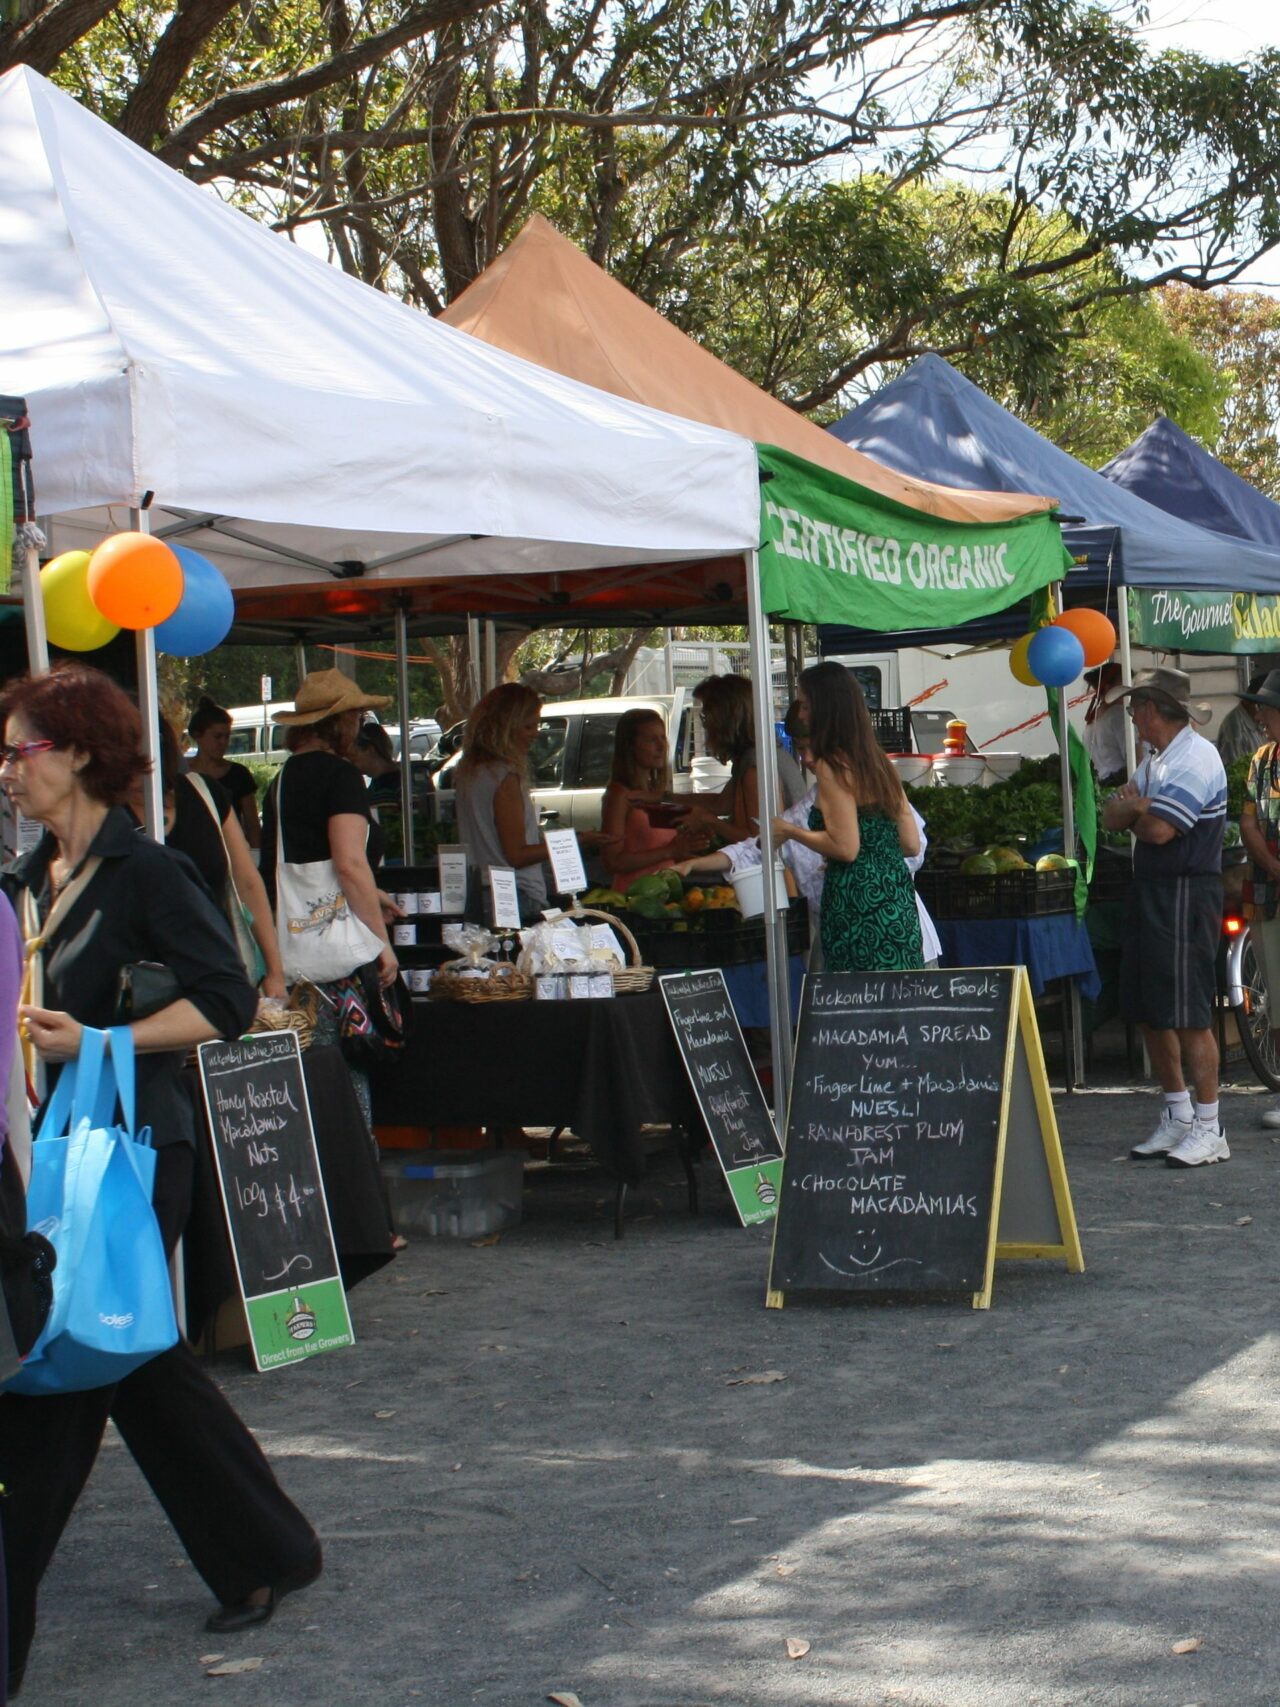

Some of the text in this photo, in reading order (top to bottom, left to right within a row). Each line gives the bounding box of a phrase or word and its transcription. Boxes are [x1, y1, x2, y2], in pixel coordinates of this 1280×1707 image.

[766, 501, 1015, 590] CERTIFIED ORGANIC
[1151, 590, 1182, 625] The
[811, 976, 1000, 1006] Tuckombil Native Foods
[919, 1024, 992, 1043] SPREAD
[860, 1074, 896, 1094] Lime
[901, 1079, 913, 1092] +
[216, 1081, 298, 1121] Honey Roasted
[851, 1100, 920, 1118] MUESLI
[916, 1119, 965, 1146] PLUM
[248, 1141, 279, 1167] Nuts
[847, 1146, 894, 1167] JAM
[801, 1174, 907, 1193] CHOCOLATE
[851, 1191, 977, 1217] MACADAMIAS
[261, 1350, 287, 1365] Direct
[286, 1346, 305, 1358] from
[304, 1342, 318, 1354] the
[318, 1333, 350, 1350] Growers
